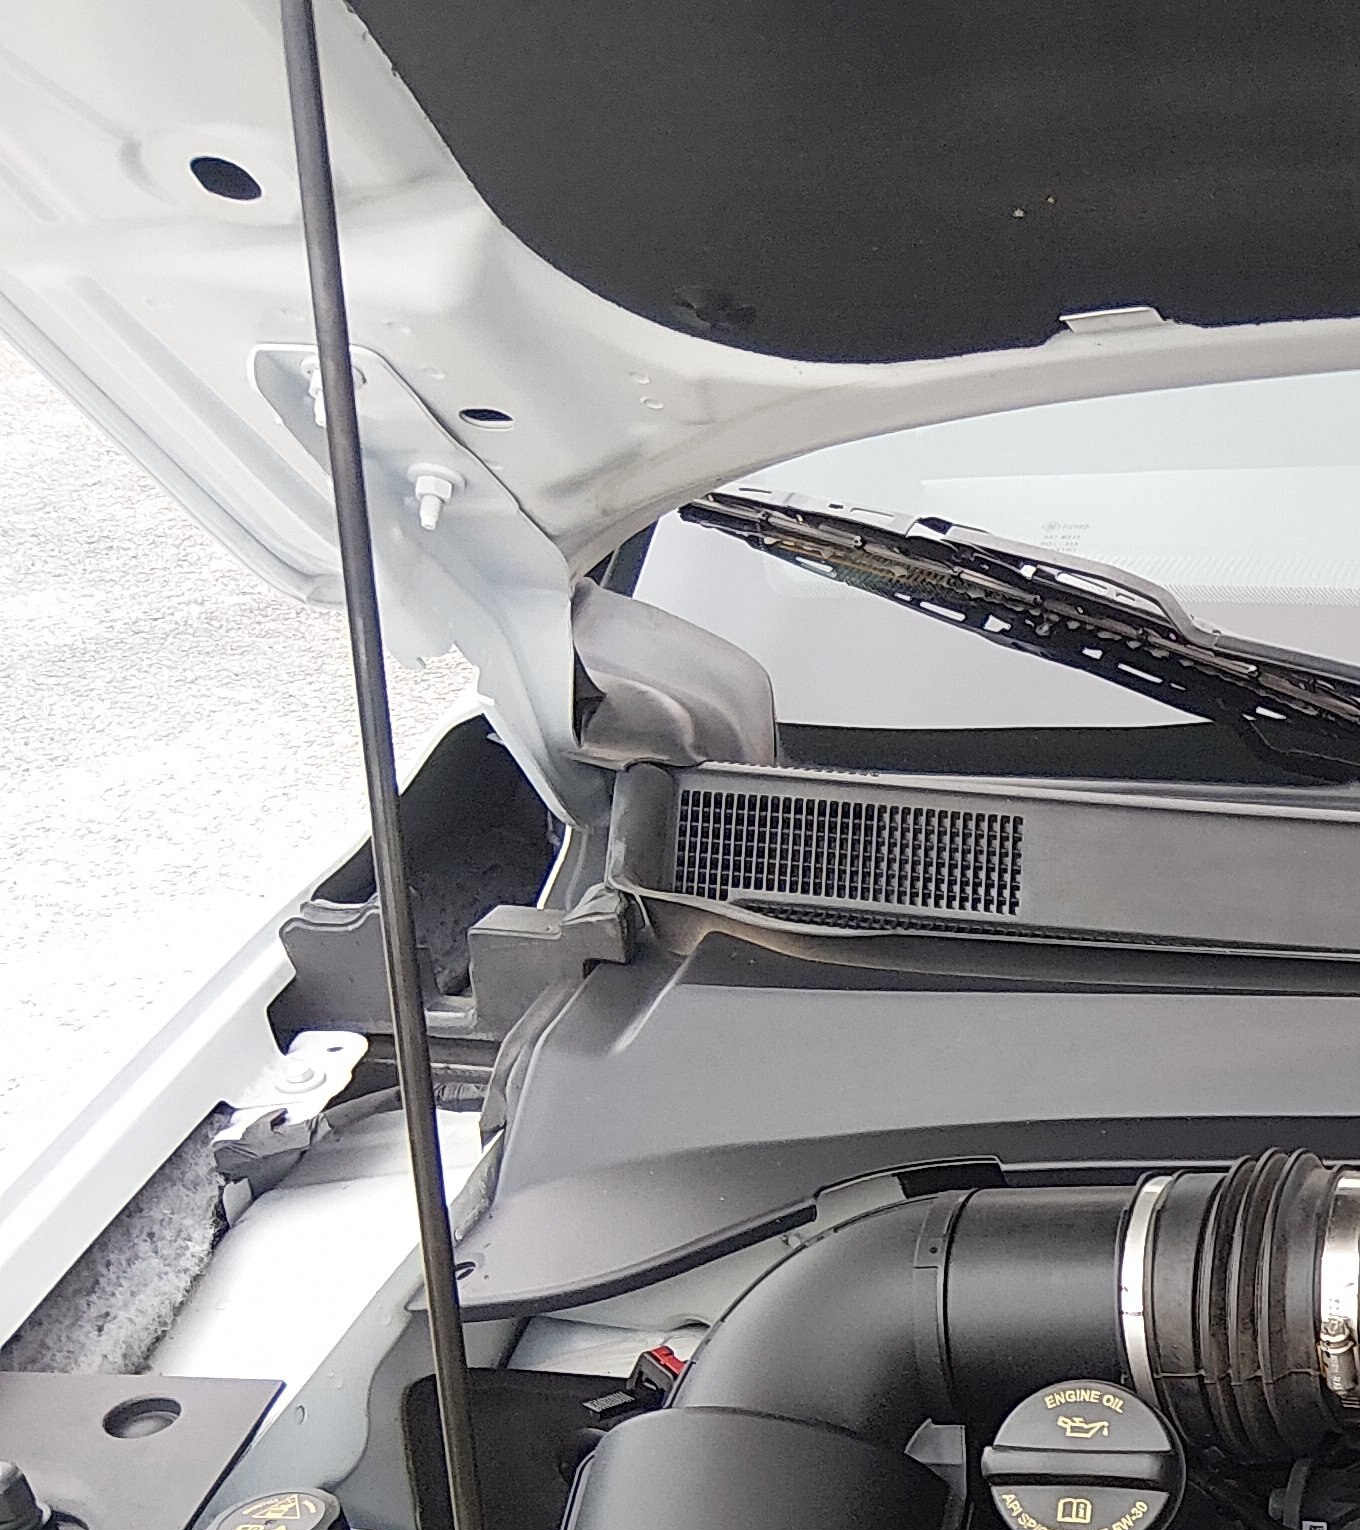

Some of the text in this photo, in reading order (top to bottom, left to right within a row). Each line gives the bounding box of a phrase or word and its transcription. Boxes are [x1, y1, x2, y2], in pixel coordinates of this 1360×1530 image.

[1044, 1389, 1126, 1413] ENGINE OIL
[1001, 1491, 1022, 1517] API
